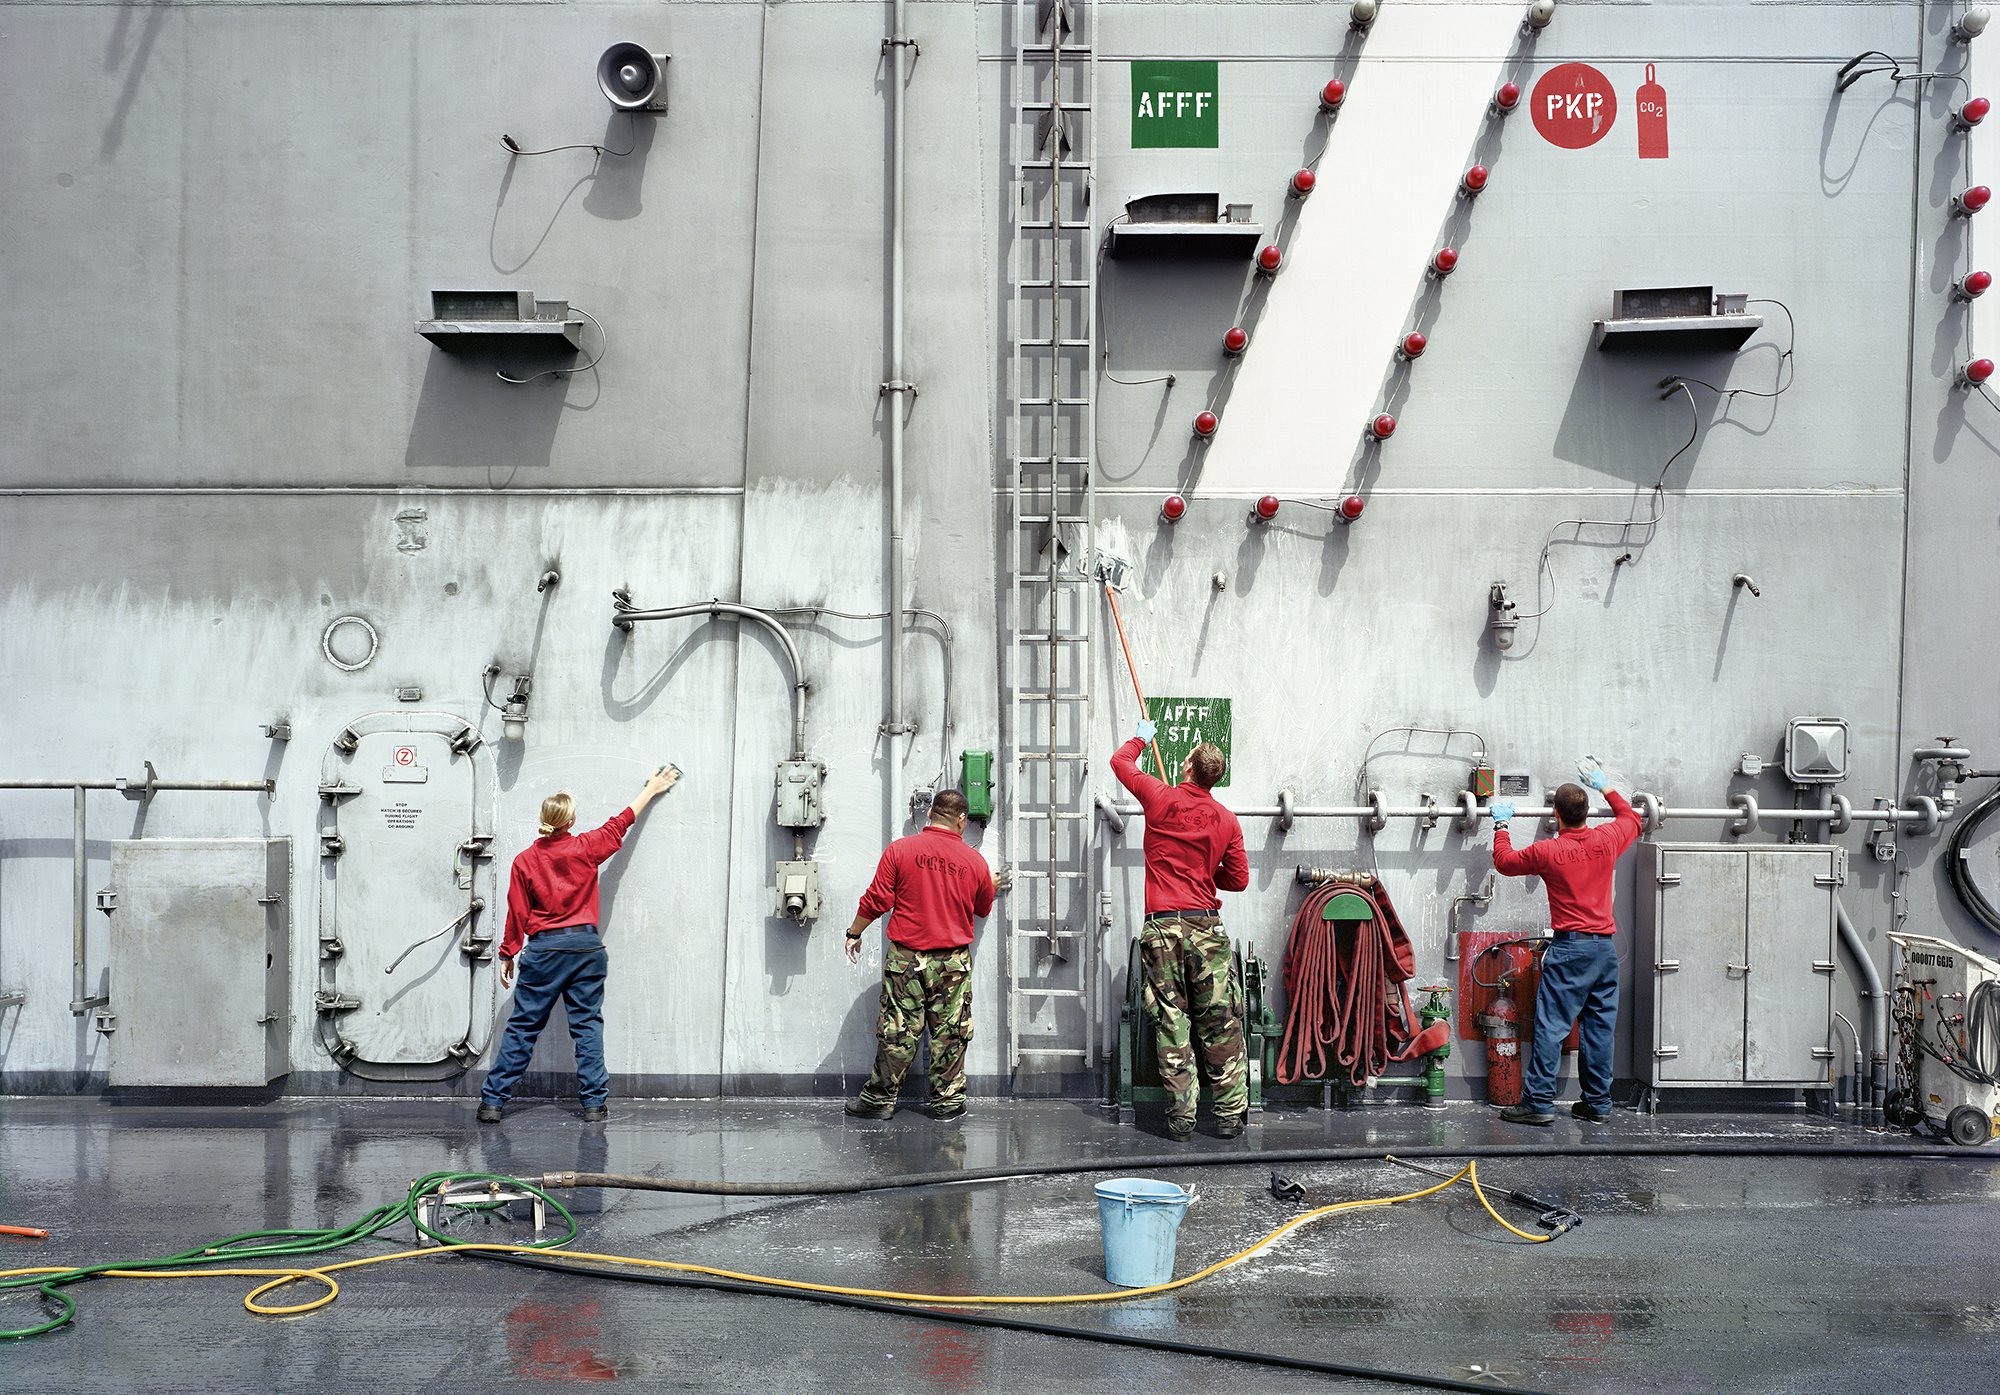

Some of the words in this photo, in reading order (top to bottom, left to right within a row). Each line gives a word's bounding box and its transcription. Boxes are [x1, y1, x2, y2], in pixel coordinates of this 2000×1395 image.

[1138, 91, 1212, 118] AFFF
[1547, 92, 1603, 120] PKP
[1164, 705, 1209, 722] AFFF
[1168, 726, 1202, 743] STA
[400, 751, 409, 763] Z
